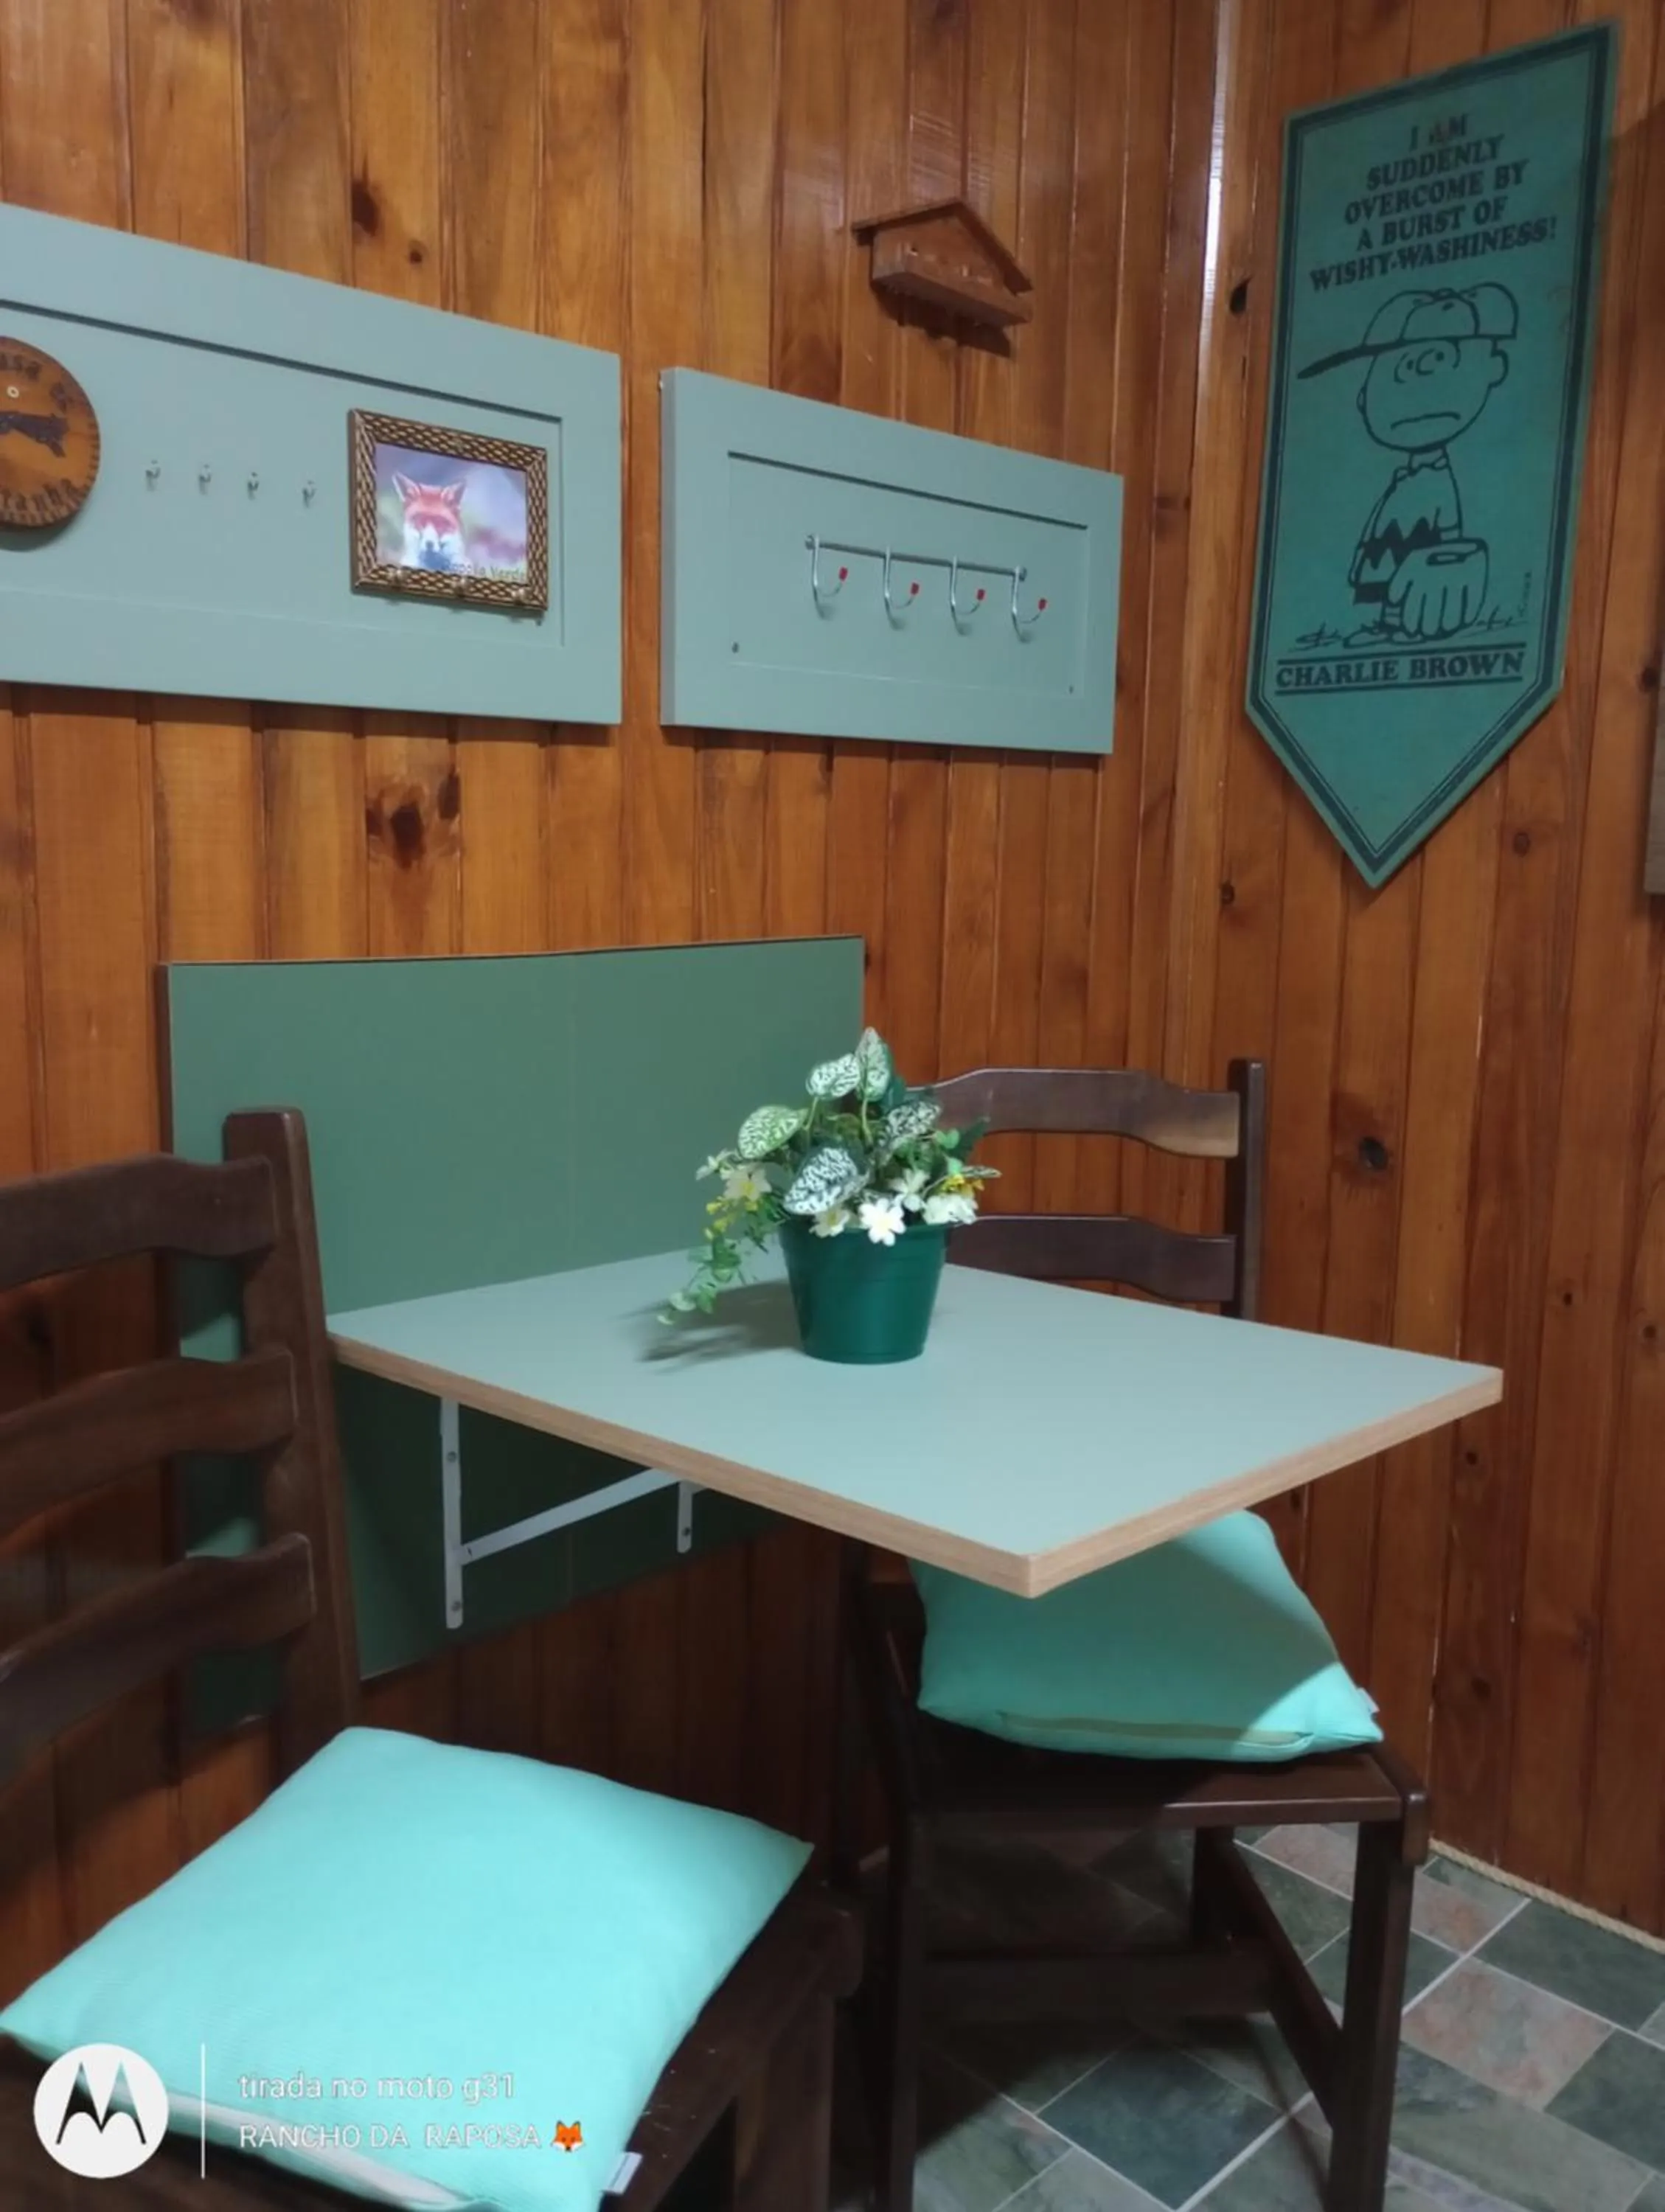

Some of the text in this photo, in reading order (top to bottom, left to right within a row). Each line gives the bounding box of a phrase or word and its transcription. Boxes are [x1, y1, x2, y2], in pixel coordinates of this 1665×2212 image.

[1409, 113, 1470, 152] I AM
[1366, 133, 1505, 191] SUDDENLY
[1344, 159, 1529, 224] OVERCOME BY
[1357, 195, 1509, 251] A BURST OF
[1309, 216, 1558, 292] WISHY-WASHINESS!
[1276, 651, 1524, 688] CHARLIE BROWN
